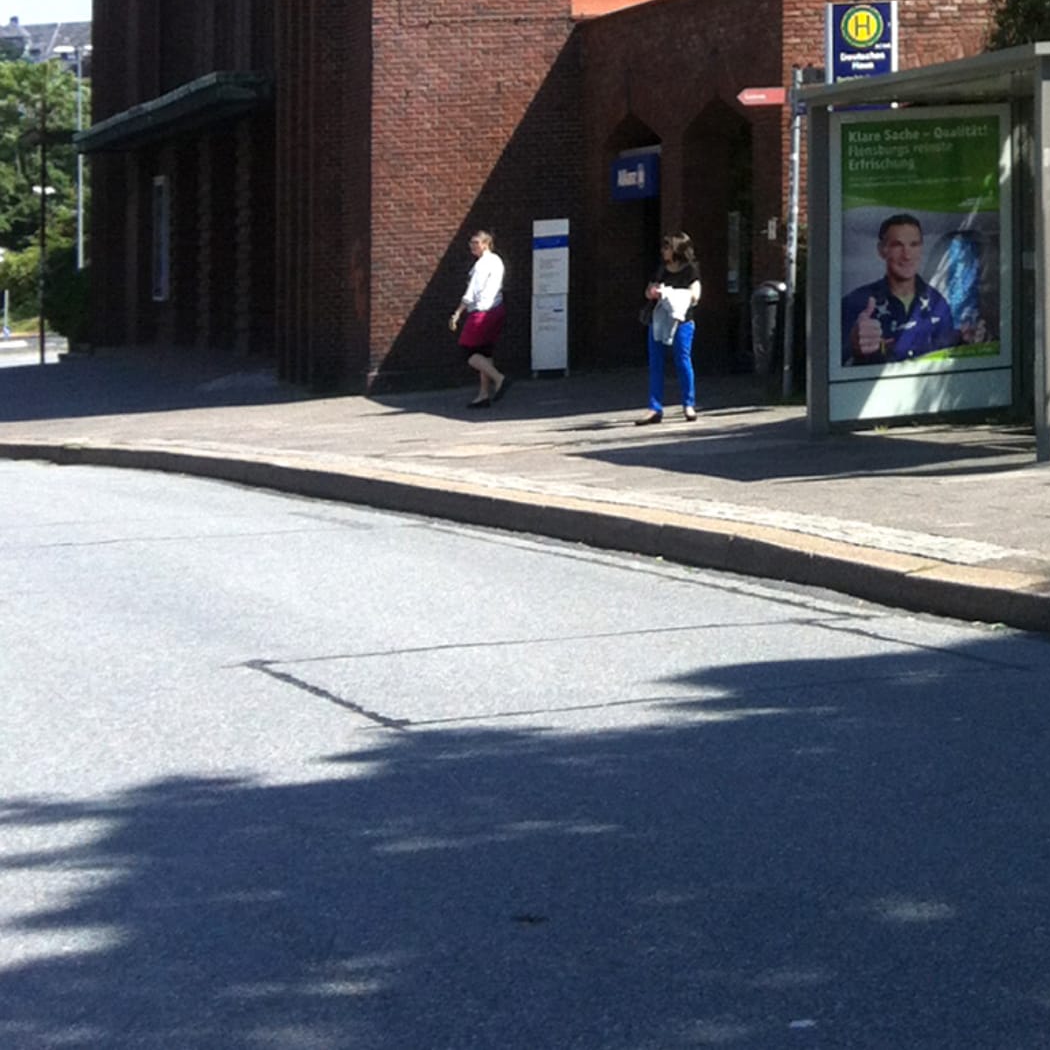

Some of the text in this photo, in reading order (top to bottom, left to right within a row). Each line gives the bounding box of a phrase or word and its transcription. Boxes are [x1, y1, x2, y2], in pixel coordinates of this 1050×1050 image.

[854, 14, 871, 38] H
[848, 130, 881, 143] Klare
[883, 127, 920, 141] Sache
[848, 157, 915, 171] Erfrischung
